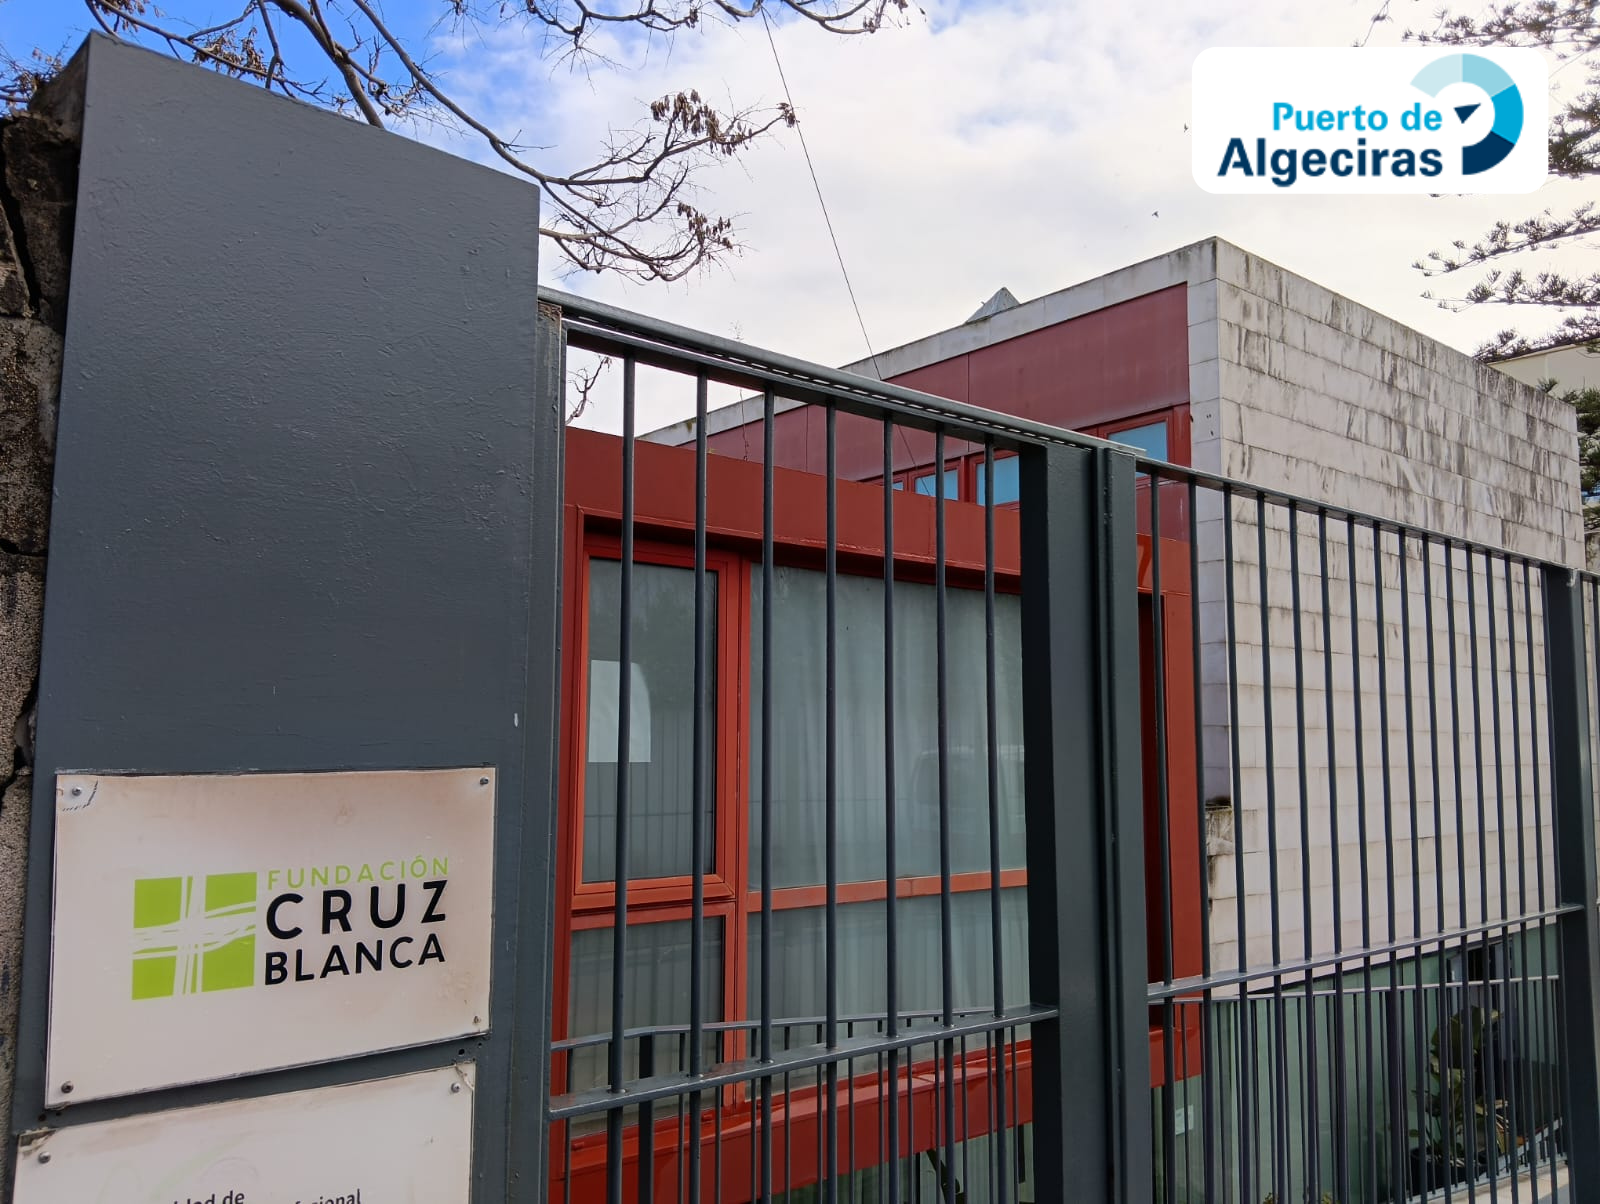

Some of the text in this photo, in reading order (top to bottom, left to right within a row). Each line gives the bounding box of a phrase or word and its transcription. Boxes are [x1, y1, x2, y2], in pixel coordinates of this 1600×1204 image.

[267, 855, 449, 890] FUNDACIÓN
[266, 880, 448, 940] CRUZ
[264, 933, 446, 986] BLANCA
[222, 1190, 245, 1204] de
